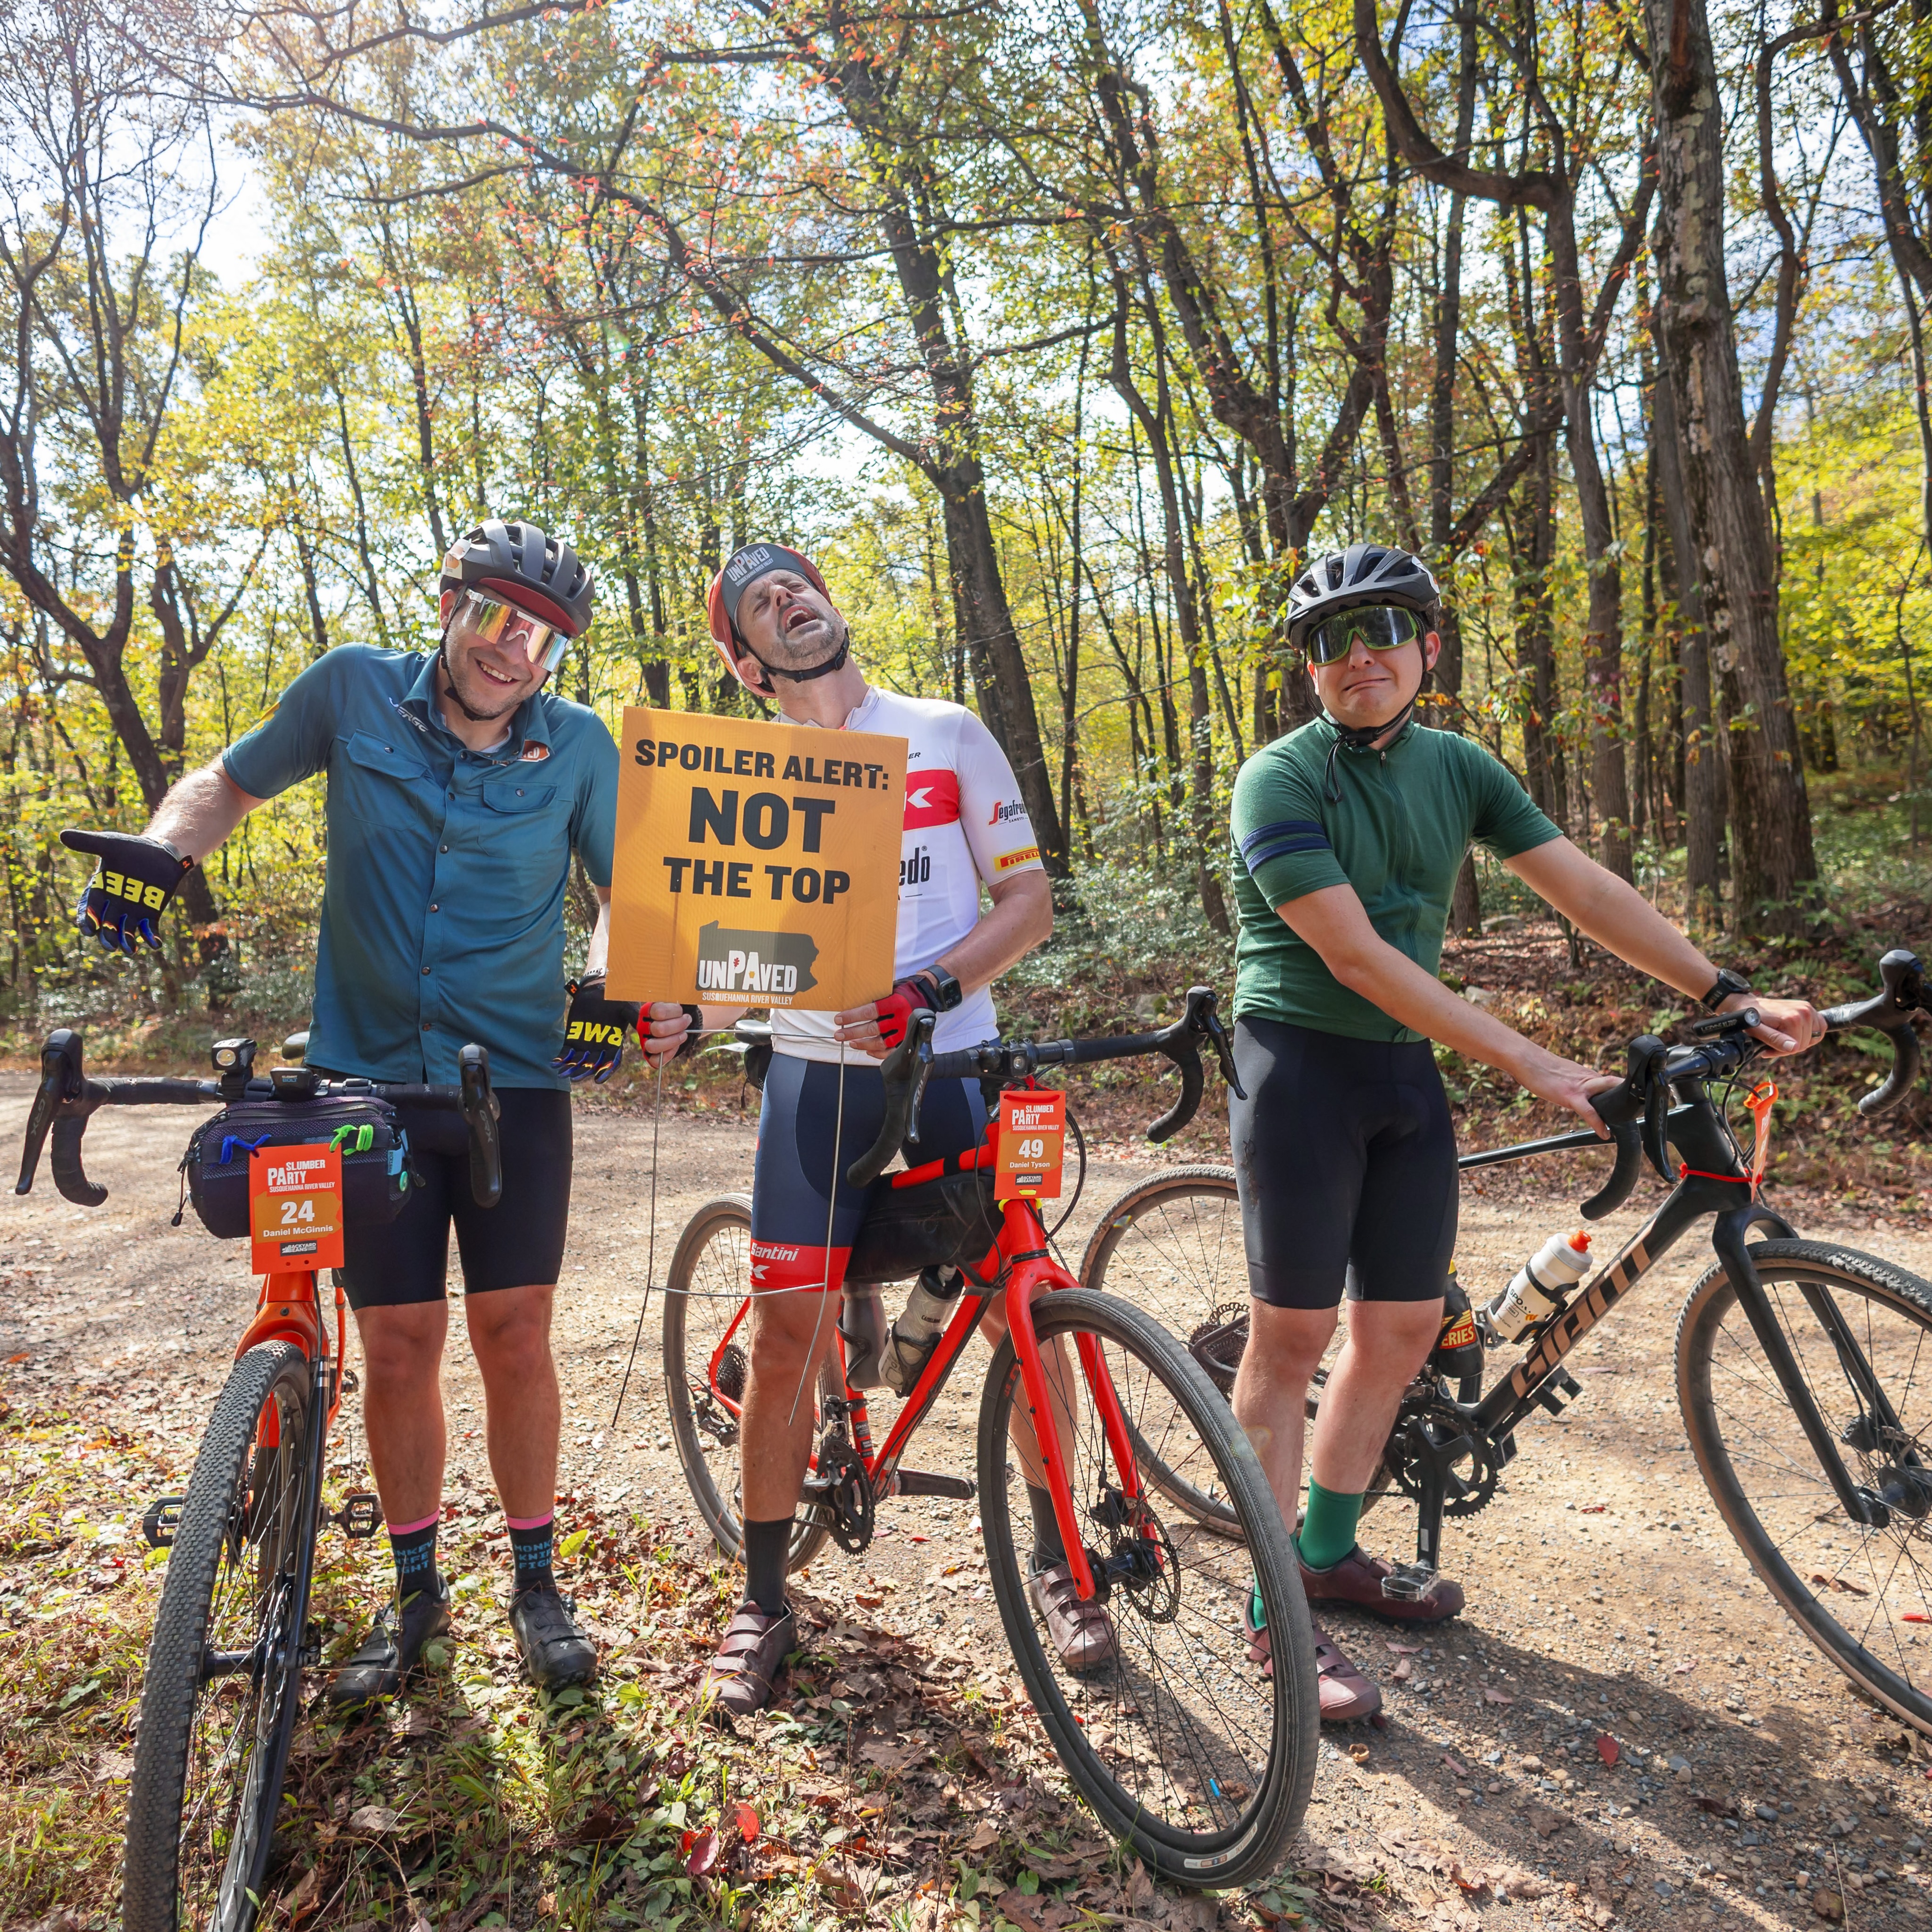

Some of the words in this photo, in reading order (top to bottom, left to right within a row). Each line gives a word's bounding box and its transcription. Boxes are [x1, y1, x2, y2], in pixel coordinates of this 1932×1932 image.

[726, 547, 770, 582] UNPAVED
[635, 739, 775, 778] SPOILER
[782, 756, 888, 790] ALERT:
[688, 786, 835, 853] NOT
[1000, 848, 1040, 868] PIRELL
[663, 857, 753, 898] THE
[765, 865, 850, 904] TOP
[699, 950, 797, 992] UNPAVED
[702, 992, 749, 1003] SUSQUEHANNA
[751, 996, 769, 1004] RIVER
[771, 996, 792, 1005] VALLEY
[31, 1098, 46, 1135] GRX
[1012, 1109, 1040, 1125] PARTY
[1025, 1105, 1054, 1113] SLUMBER
[479, 1109, 493, 1143] GRX
[1019, 1139, 1043, 1158] 49
[286, 1159, 325, 1171] SLUMBER
[267, 1167, 307, 1186] PARTY
[269, 1184, 304, 1192] SUSQUEHANNA
[281, 1200, 315, 1224] 24
[263, 1228, 291, 1237] Daniel
[293, 1225, 333, 1234] McGinnis
[751, 1242, 799, 1261] Santini
[1441, 1326, 1474, 1347] ERIES
[515, 1539, 551, 1552] MONK
[519, 1548, 551, 1561] KNIF
[519, 1557, 551, 1569] FIGH
